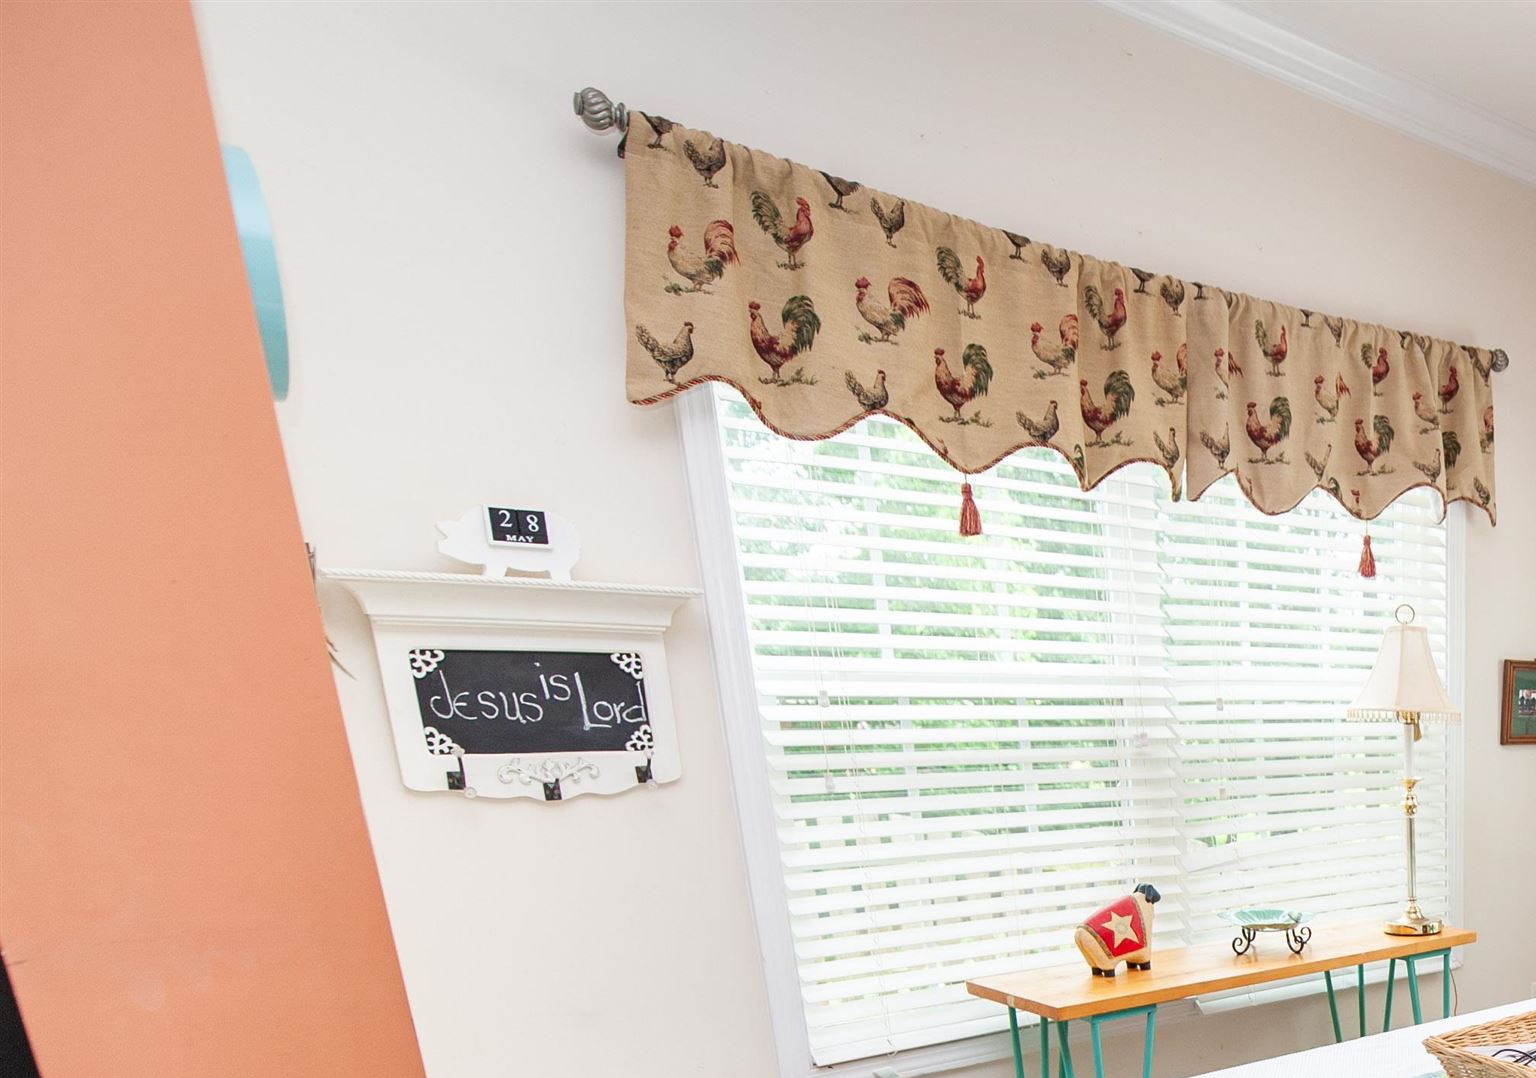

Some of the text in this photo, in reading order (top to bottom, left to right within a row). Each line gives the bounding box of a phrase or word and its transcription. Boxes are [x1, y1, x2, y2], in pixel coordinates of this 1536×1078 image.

[505, 534, 535, 543] MAY
[430, 662, 647, 731] Jesus is Lord
